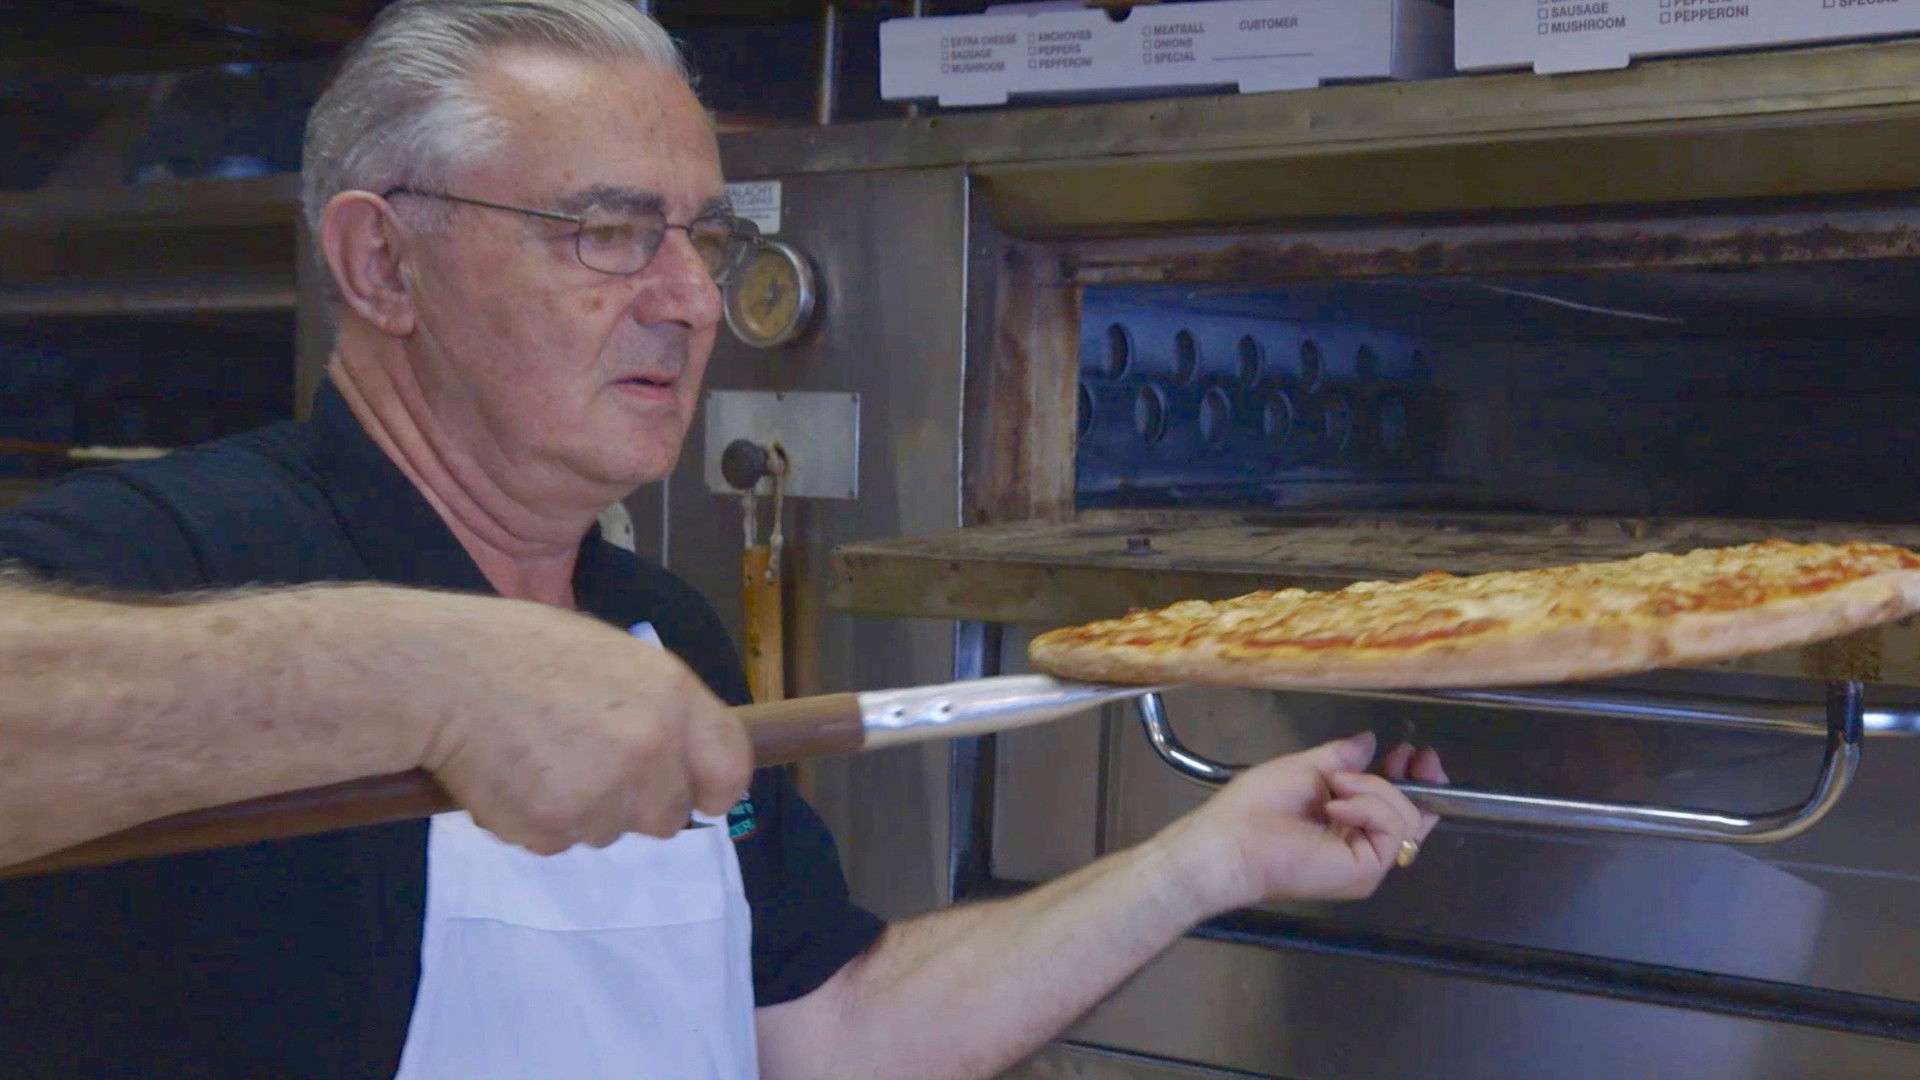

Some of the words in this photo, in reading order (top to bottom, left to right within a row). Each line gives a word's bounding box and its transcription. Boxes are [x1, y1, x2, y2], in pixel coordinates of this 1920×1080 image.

[1551, 2, 1609, 18] SAUSAGE
[1674, 5, 1749, 22] PEPPERONI
[1153, 23, 1205, 36] MEATBALL
[1239, 17, 1298, 31] CUSTOMER
[1551, 16, 1626, 34] MUSHROOM
[951, 36, 979, 47] EXTRA
[981, 33, 1017, 45] CHEESE
[1038, 29, 1092, 42] ANCHOVIES
[1038, 43, 1081, 55] PEPPERS
[1154, 38, 1193, 49] ONIONS
[951, 48, 992, 59] SAUSAGE
[1154, 51, 1195, 64] SPECIAL
[951, 61, 1006, 73] MUSHROOM
[1038, 57, 1092, 69] PEPPERONI
